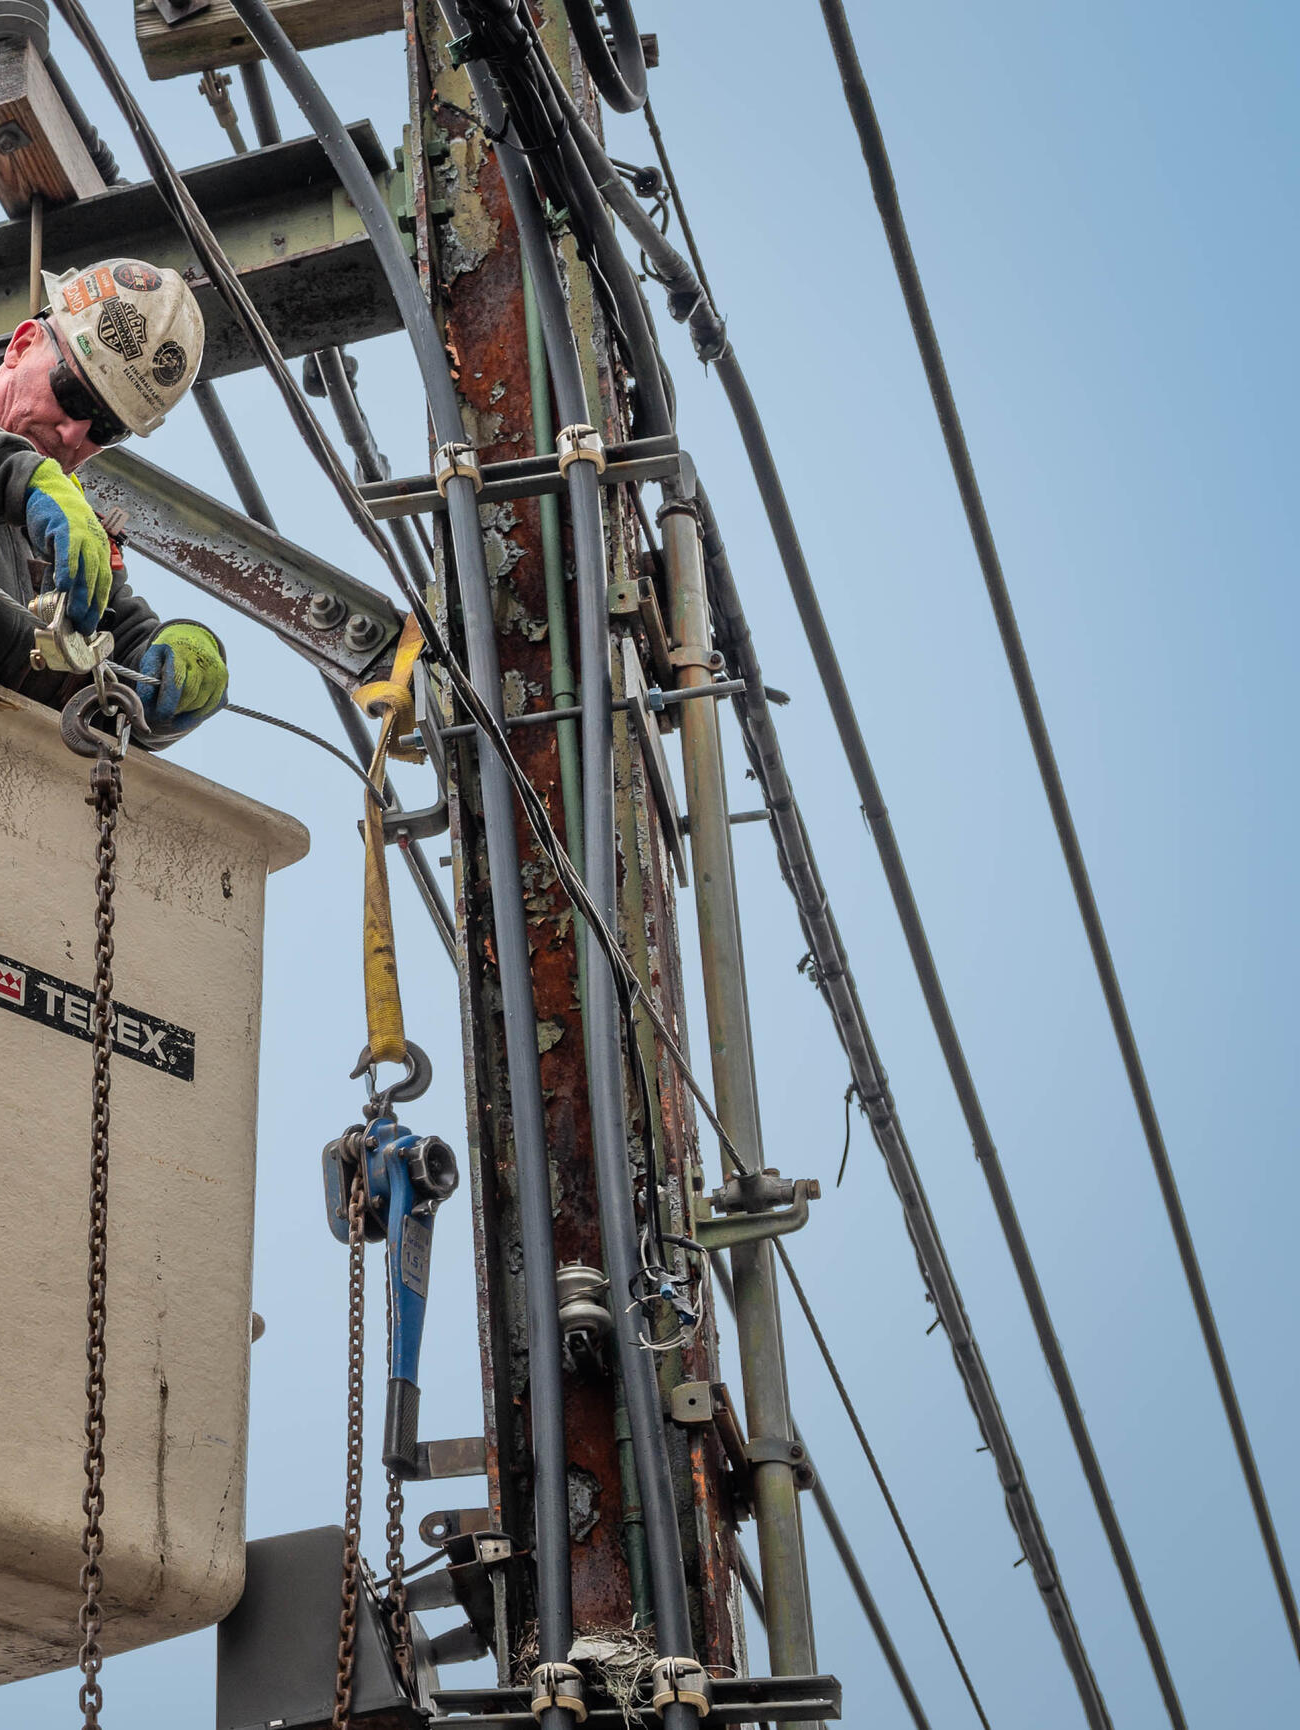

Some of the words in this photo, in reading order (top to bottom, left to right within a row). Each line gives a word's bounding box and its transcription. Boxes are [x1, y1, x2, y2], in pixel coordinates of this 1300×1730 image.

[101, 320, 119, 346] 103
[108, 303, 122, 331] RIDING
[120, 332, 133, 355] CLUB
[114, 302, 138, 353] MOTORCYCLE
[124, 307, 142, 339] LOCAL
